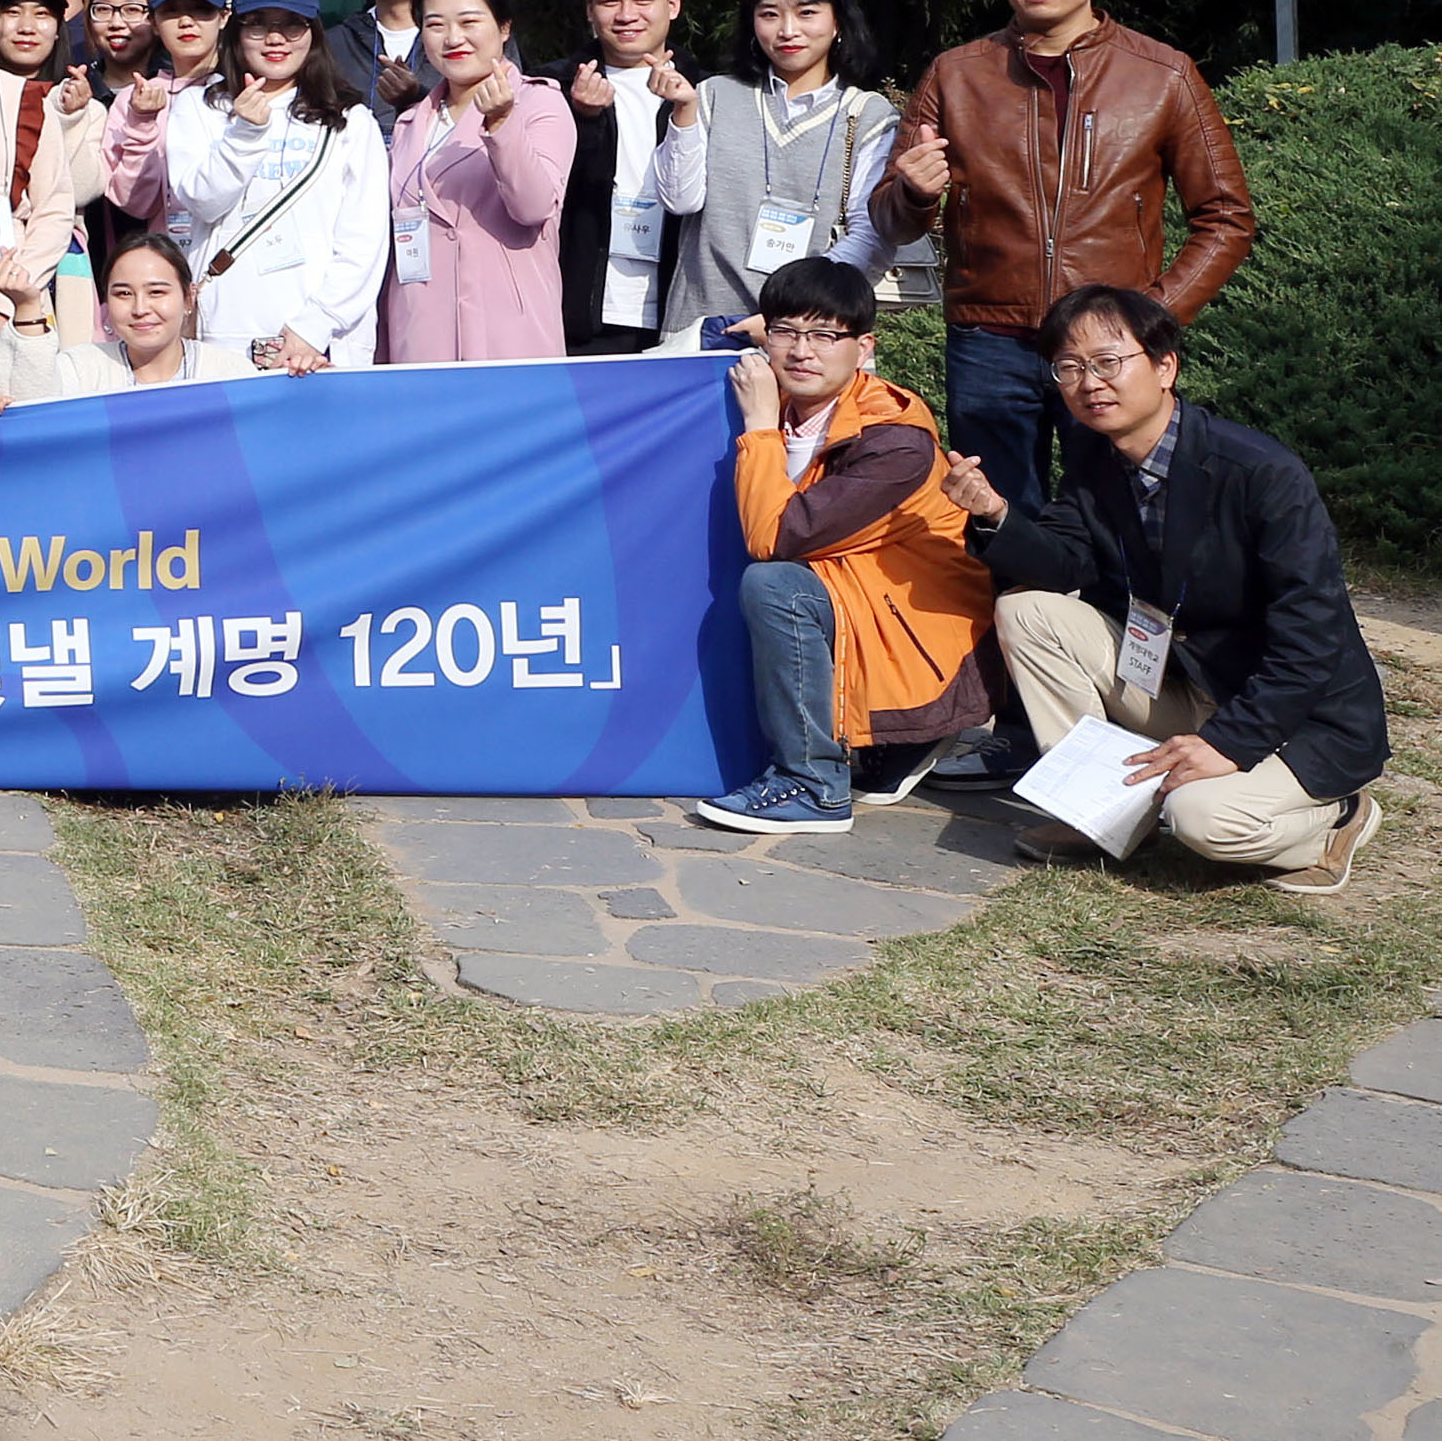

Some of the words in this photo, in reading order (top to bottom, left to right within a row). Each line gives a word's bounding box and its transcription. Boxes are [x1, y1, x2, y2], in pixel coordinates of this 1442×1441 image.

[130, 610, 303, 698] 계명
[338, 596, 623, 691] 120년」
[1129, 656, 1152, 676] STAFF
